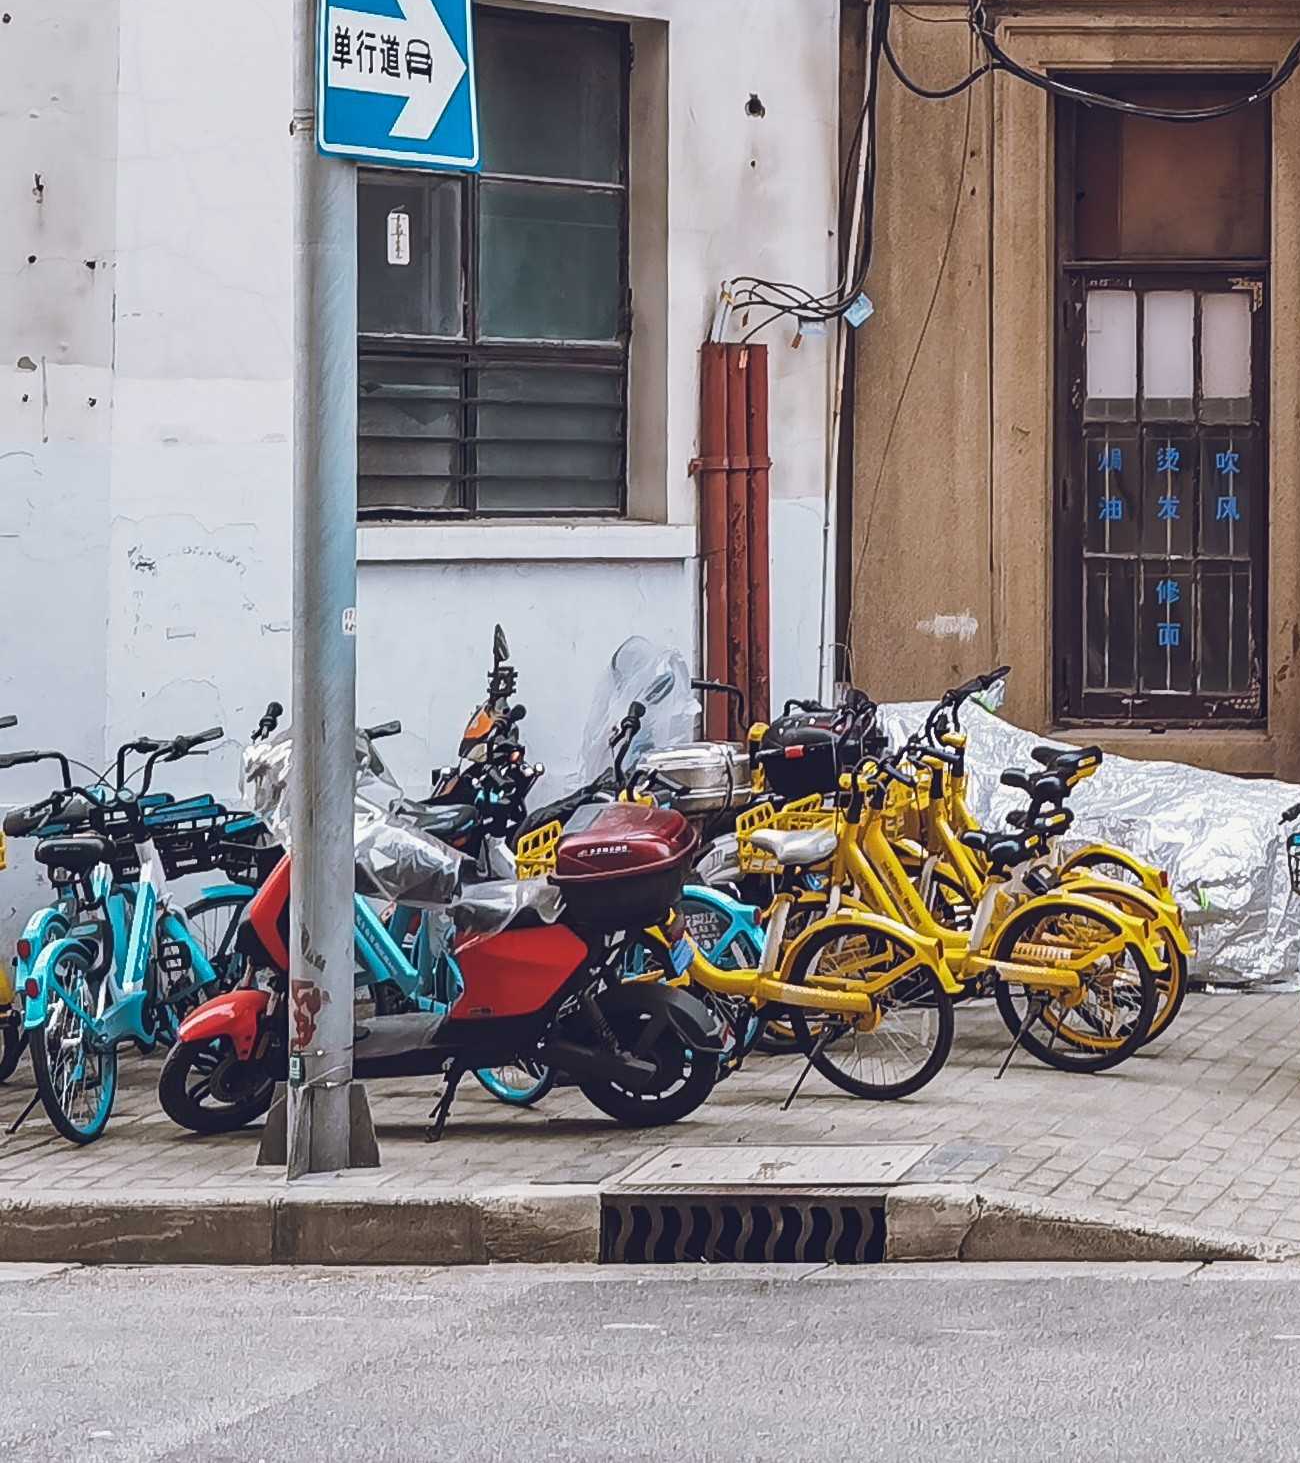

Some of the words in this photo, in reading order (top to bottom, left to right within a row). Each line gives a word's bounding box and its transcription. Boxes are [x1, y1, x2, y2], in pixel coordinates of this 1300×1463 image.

[332, 25, 401, 78] 单行道
[1157, 447, 1180, 520] 烫发
[1216, 449, 1240, 520] 吹风
[1156, 580, 1181, 646] 修面
